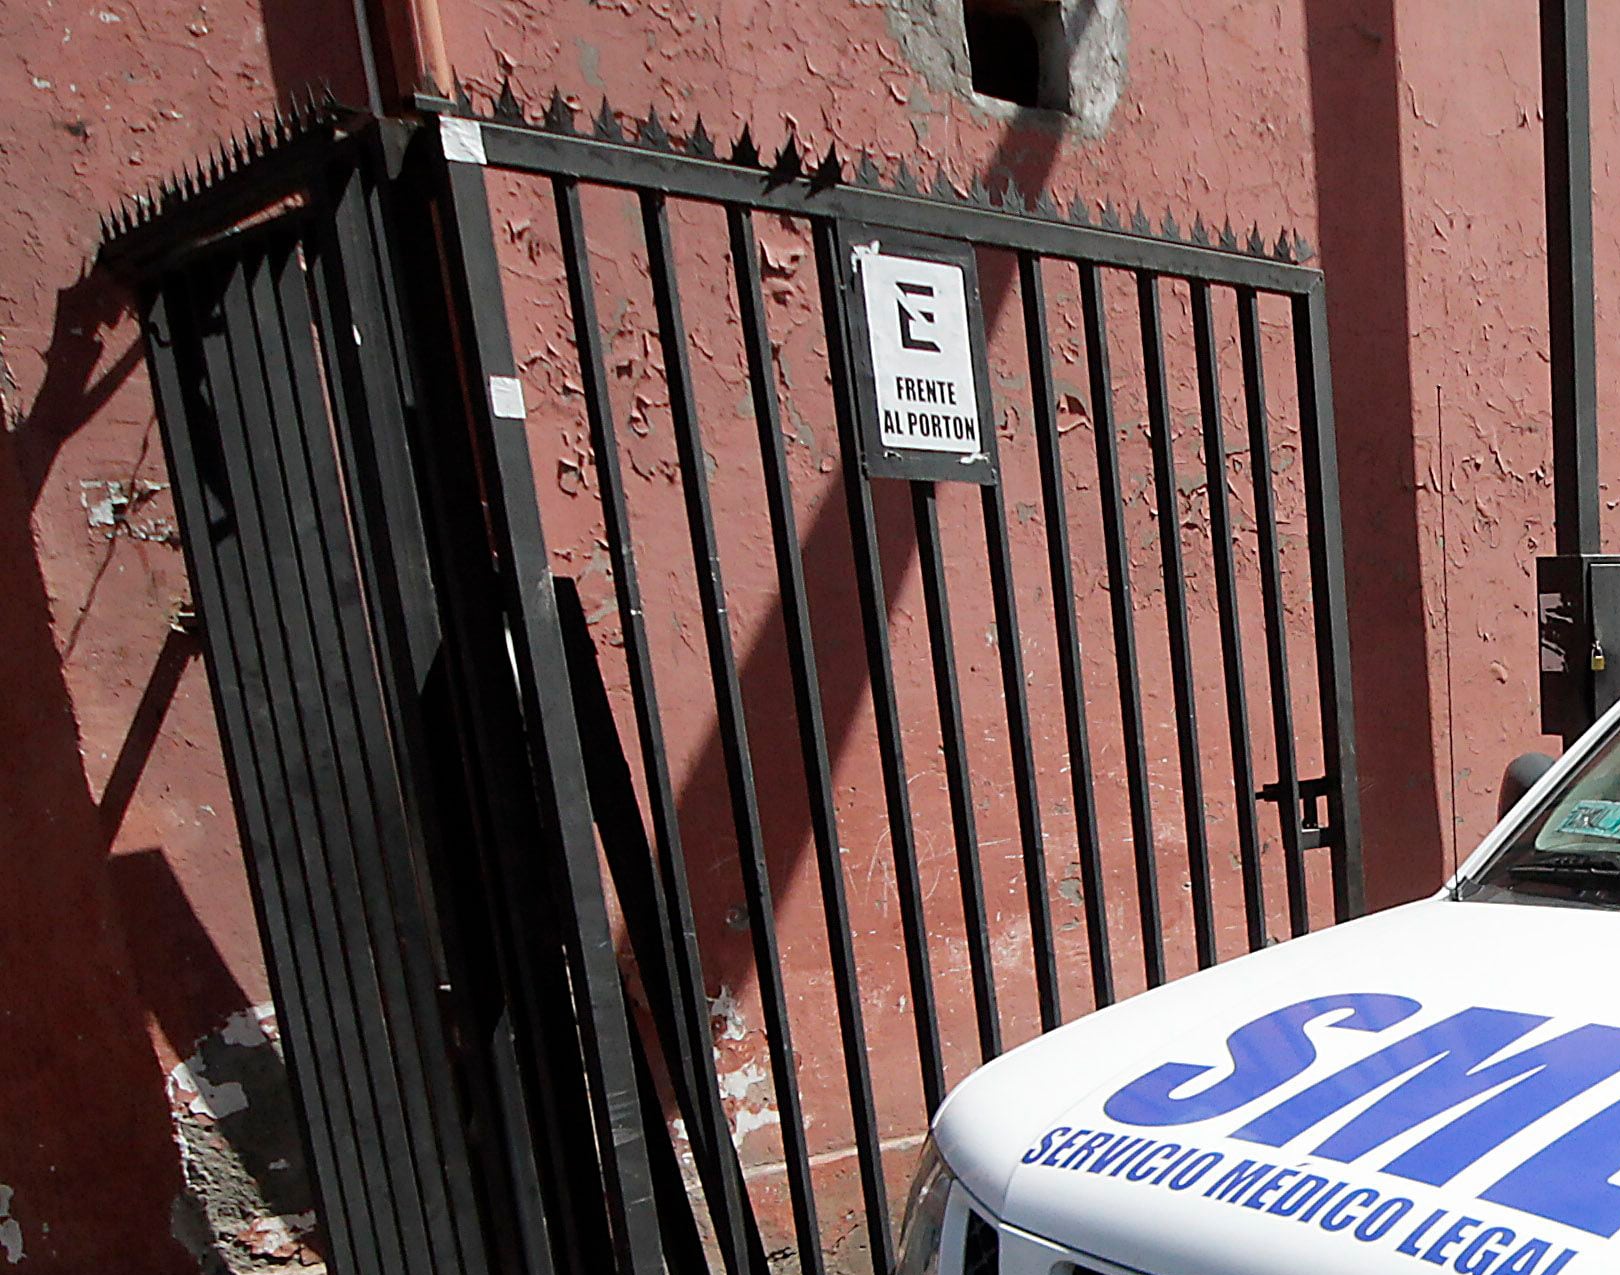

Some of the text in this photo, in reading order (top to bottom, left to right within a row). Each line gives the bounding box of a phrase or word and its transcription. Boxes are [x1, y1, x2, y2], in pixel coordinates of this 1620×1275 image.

[896, 376, 957, 406] FRENTE
[883, 409, 976, 441] AL PORTON
[1021, 1127, 1223, 1191] SERVICIO
[1204, 1163, 1415, 1240] MÉDICO
